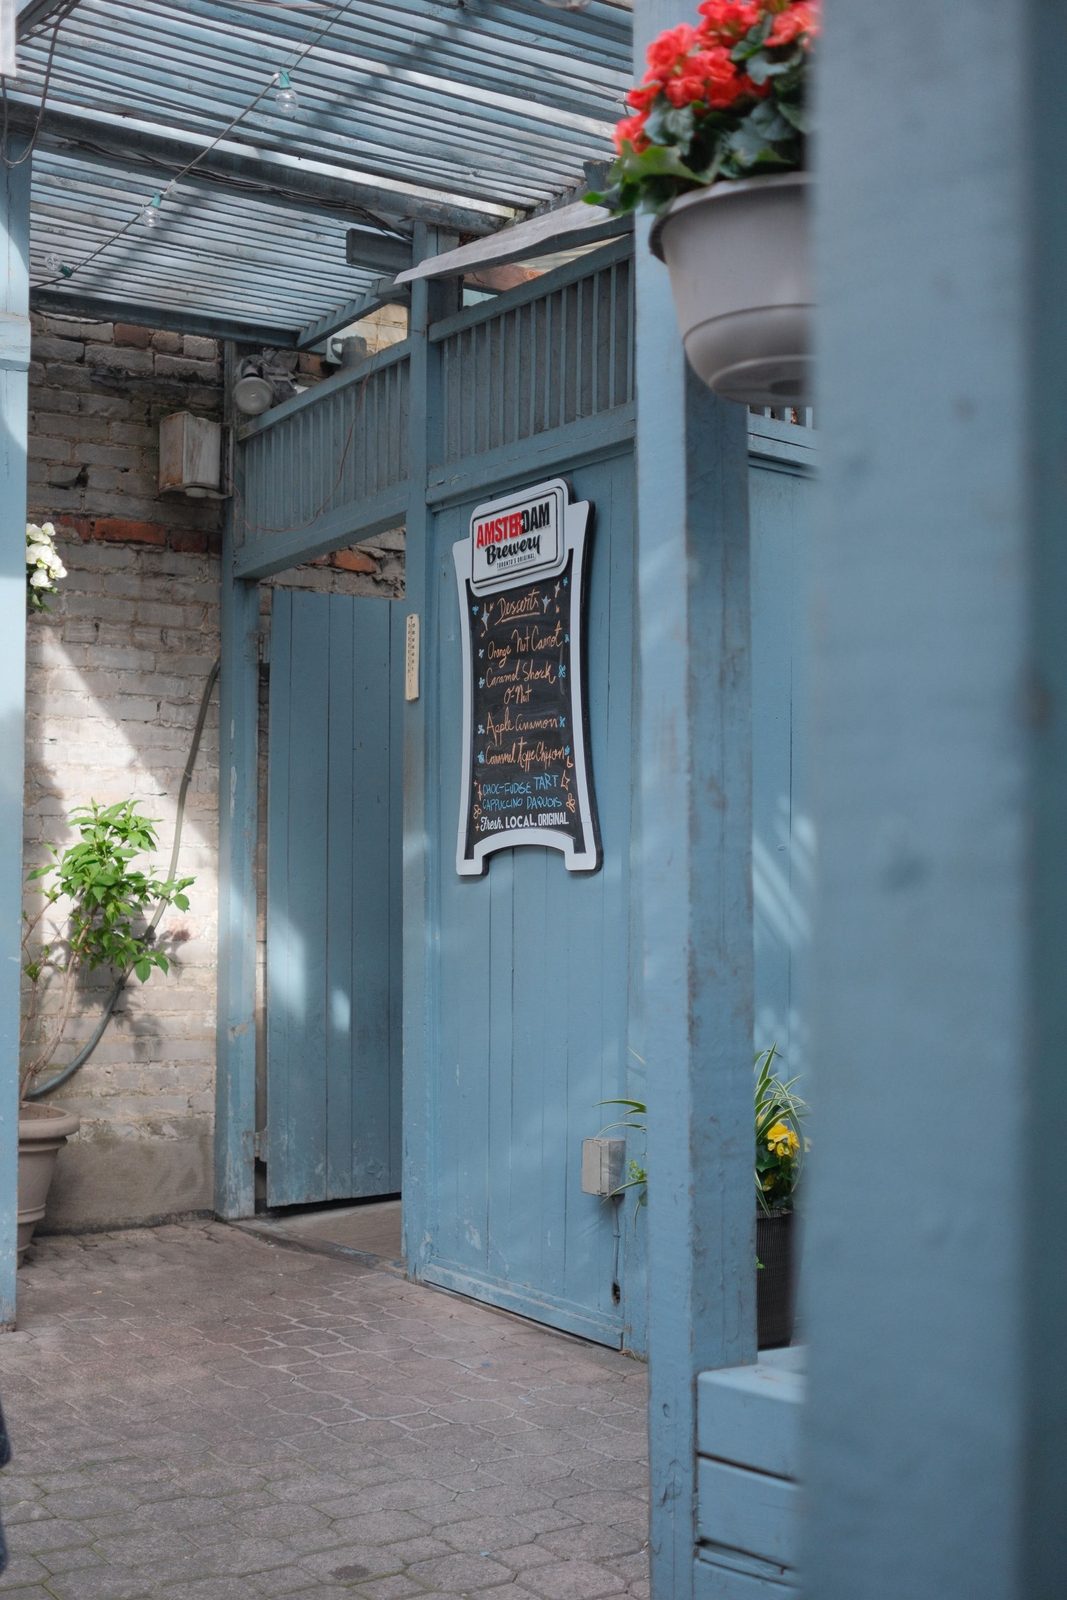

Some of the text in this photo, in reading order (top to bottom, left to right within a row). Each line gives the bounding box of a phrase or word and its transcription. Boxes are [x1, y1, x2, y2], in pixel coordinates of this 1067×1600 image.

[476, 501, 550, 549] AMSTERDAM
[484, 534, 541, 565] Brewery
[494, 588, 540, 626] Desserts
[487, 620, 563, 668] Orange Nut Carrot
[486, 659, 520, 688] Caramel
[486, 706, 514, 747] Apple
[533, 772, 559, 791] TART
[505, 813, 537, 829] LOCAL.
